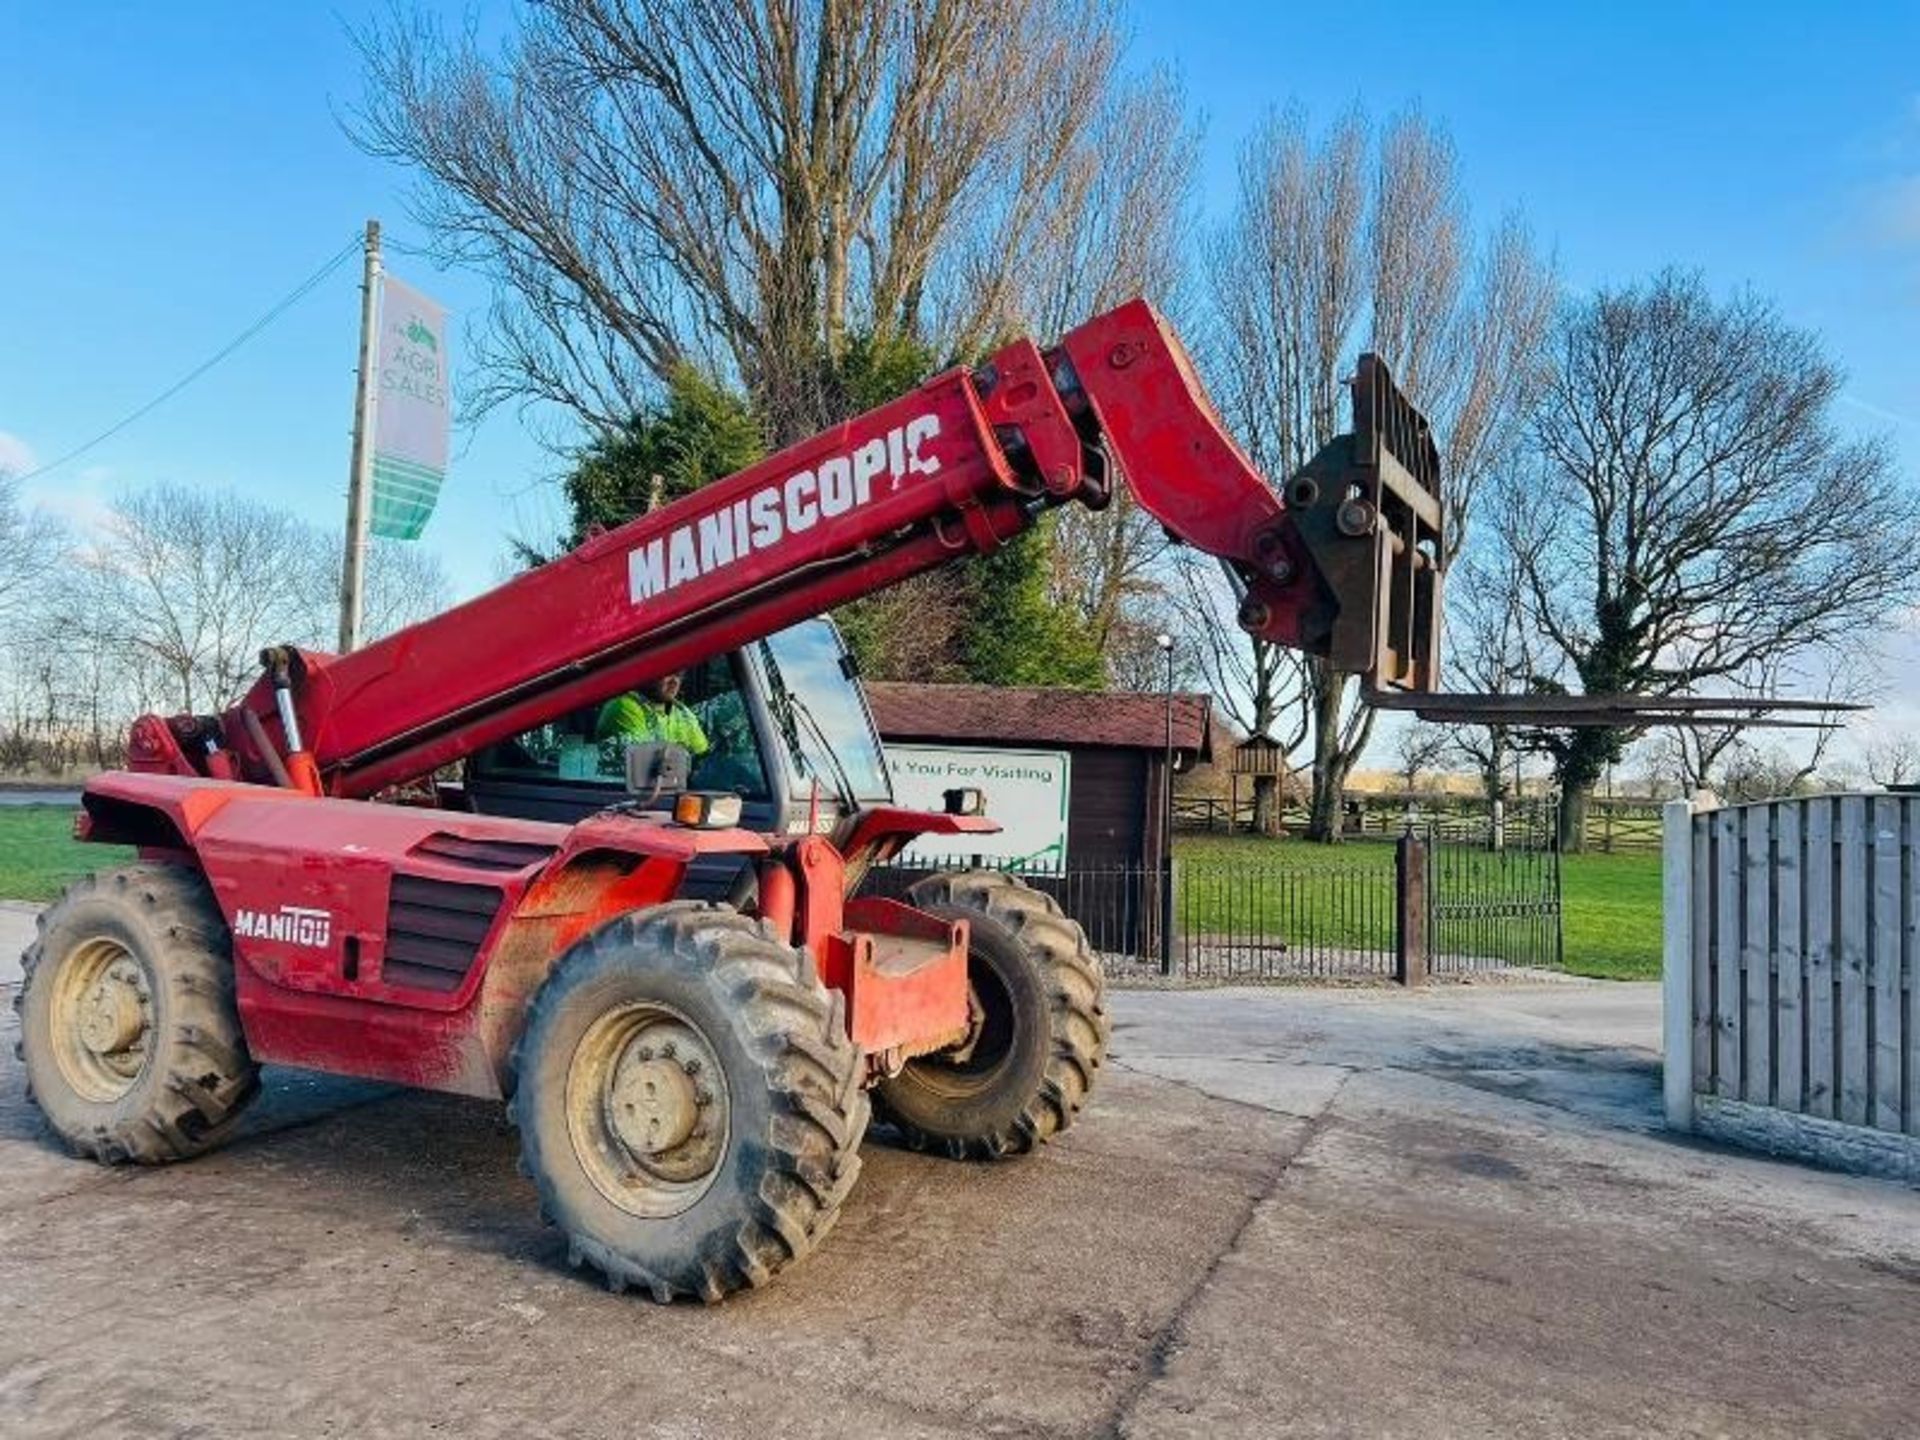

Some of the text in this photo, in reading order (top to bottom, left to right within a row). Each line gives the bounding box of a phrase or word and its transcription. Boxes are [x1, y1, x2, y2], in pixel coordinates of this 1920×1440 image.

[392, 345, 440, 382] AGRI
[383, 368, 445, 408] SALES
[628, 413, 941, 605] MANISCOPIC
[906, 761, 941, 775] You
[947, 763, 976, 776] For
[981, 765, 1053, 783] Visiting
[235, 905, 331, 948] MANITOU
